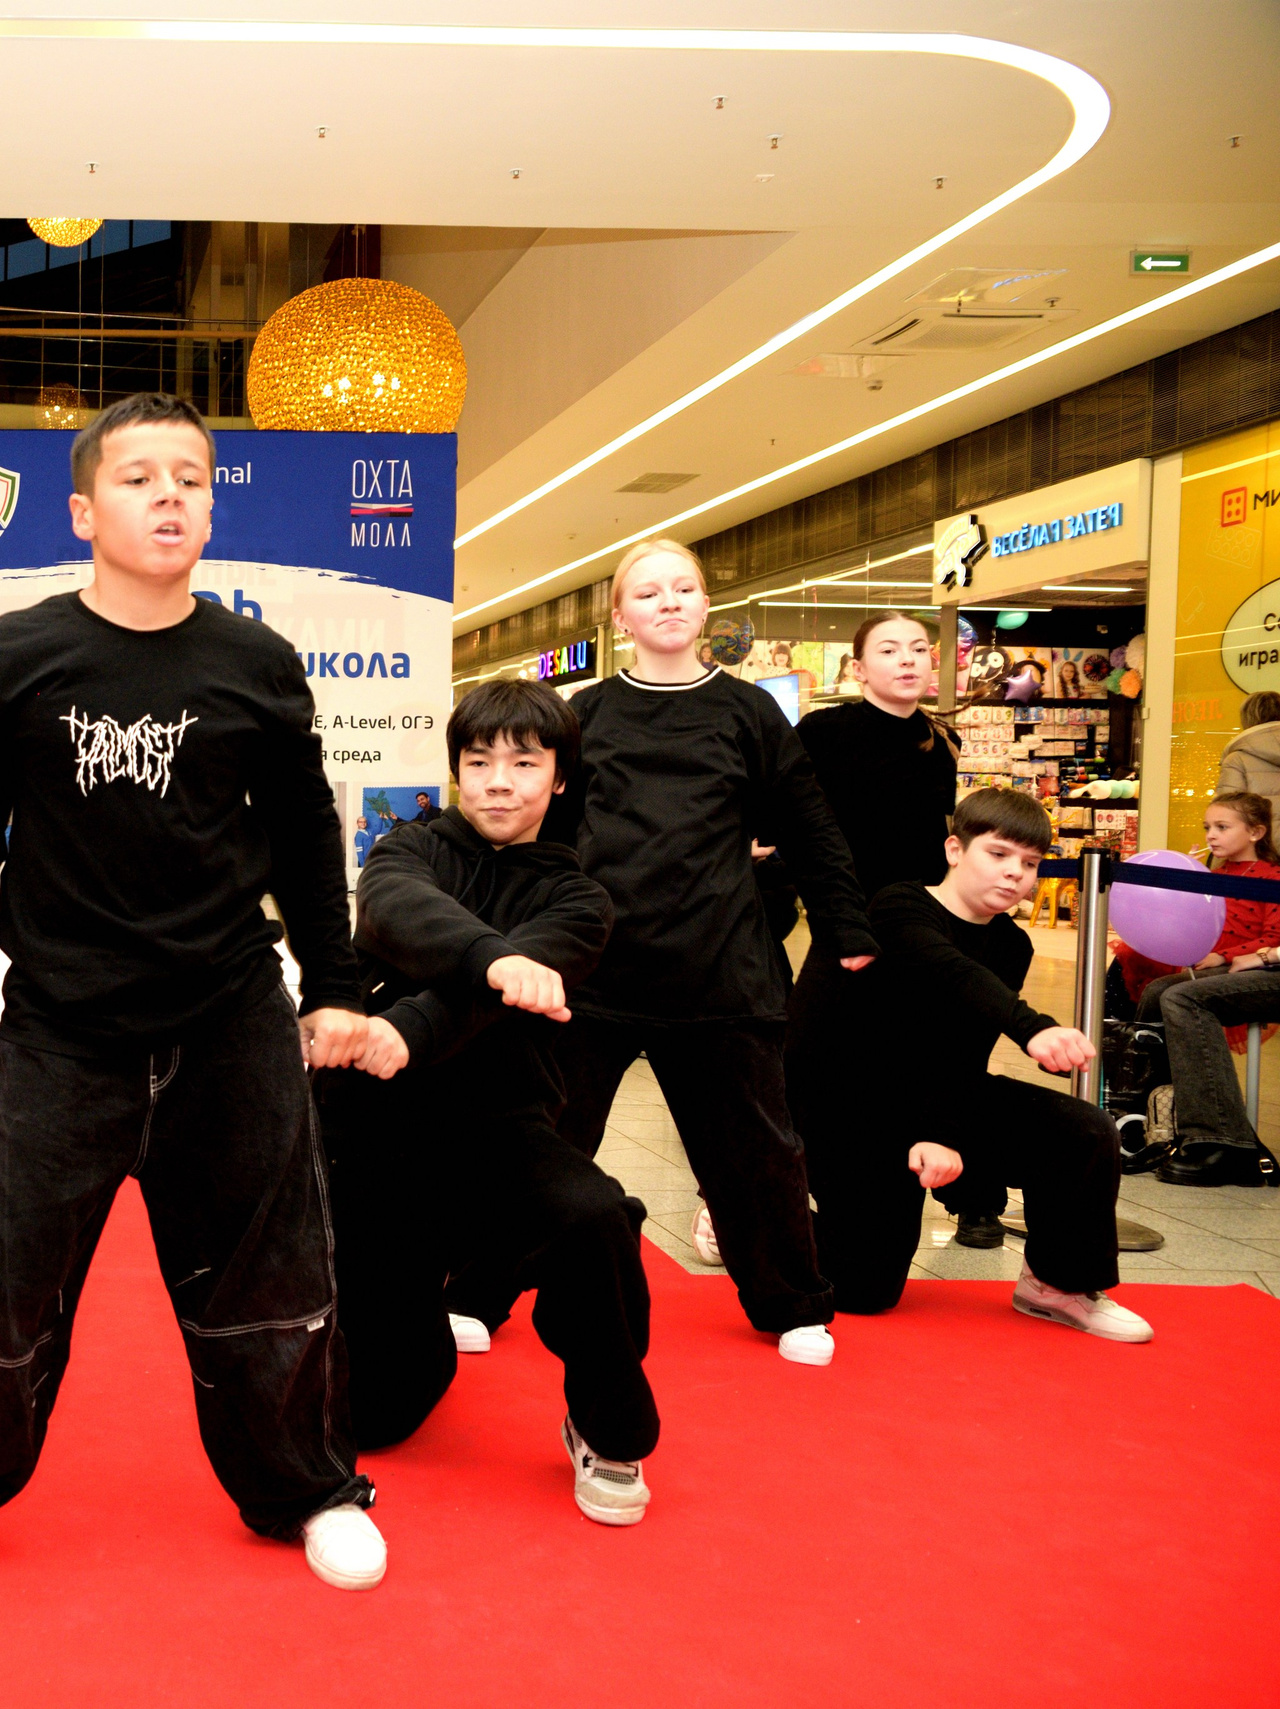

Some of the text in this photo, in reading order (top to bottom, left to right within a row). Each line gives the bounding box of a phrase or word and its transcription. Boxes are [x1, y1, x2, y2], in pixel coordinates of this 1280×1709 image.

[215, 461, 251, 484] nal
[352, 459, 413, 498] ОХТА
[350, 522, 412, 547] МОЛЛ
[991, 519, 1062, 558] ВЕСЁЛАЯ
[1063, 502, 1124, 541] ЗАТЕЯ
[538, 641, 587, 680] DESALU
[333, 714, 396, 731] A-Level,
[401, 715, 434, 729] ОГЭ
[333, 750, 381, 764] среда
